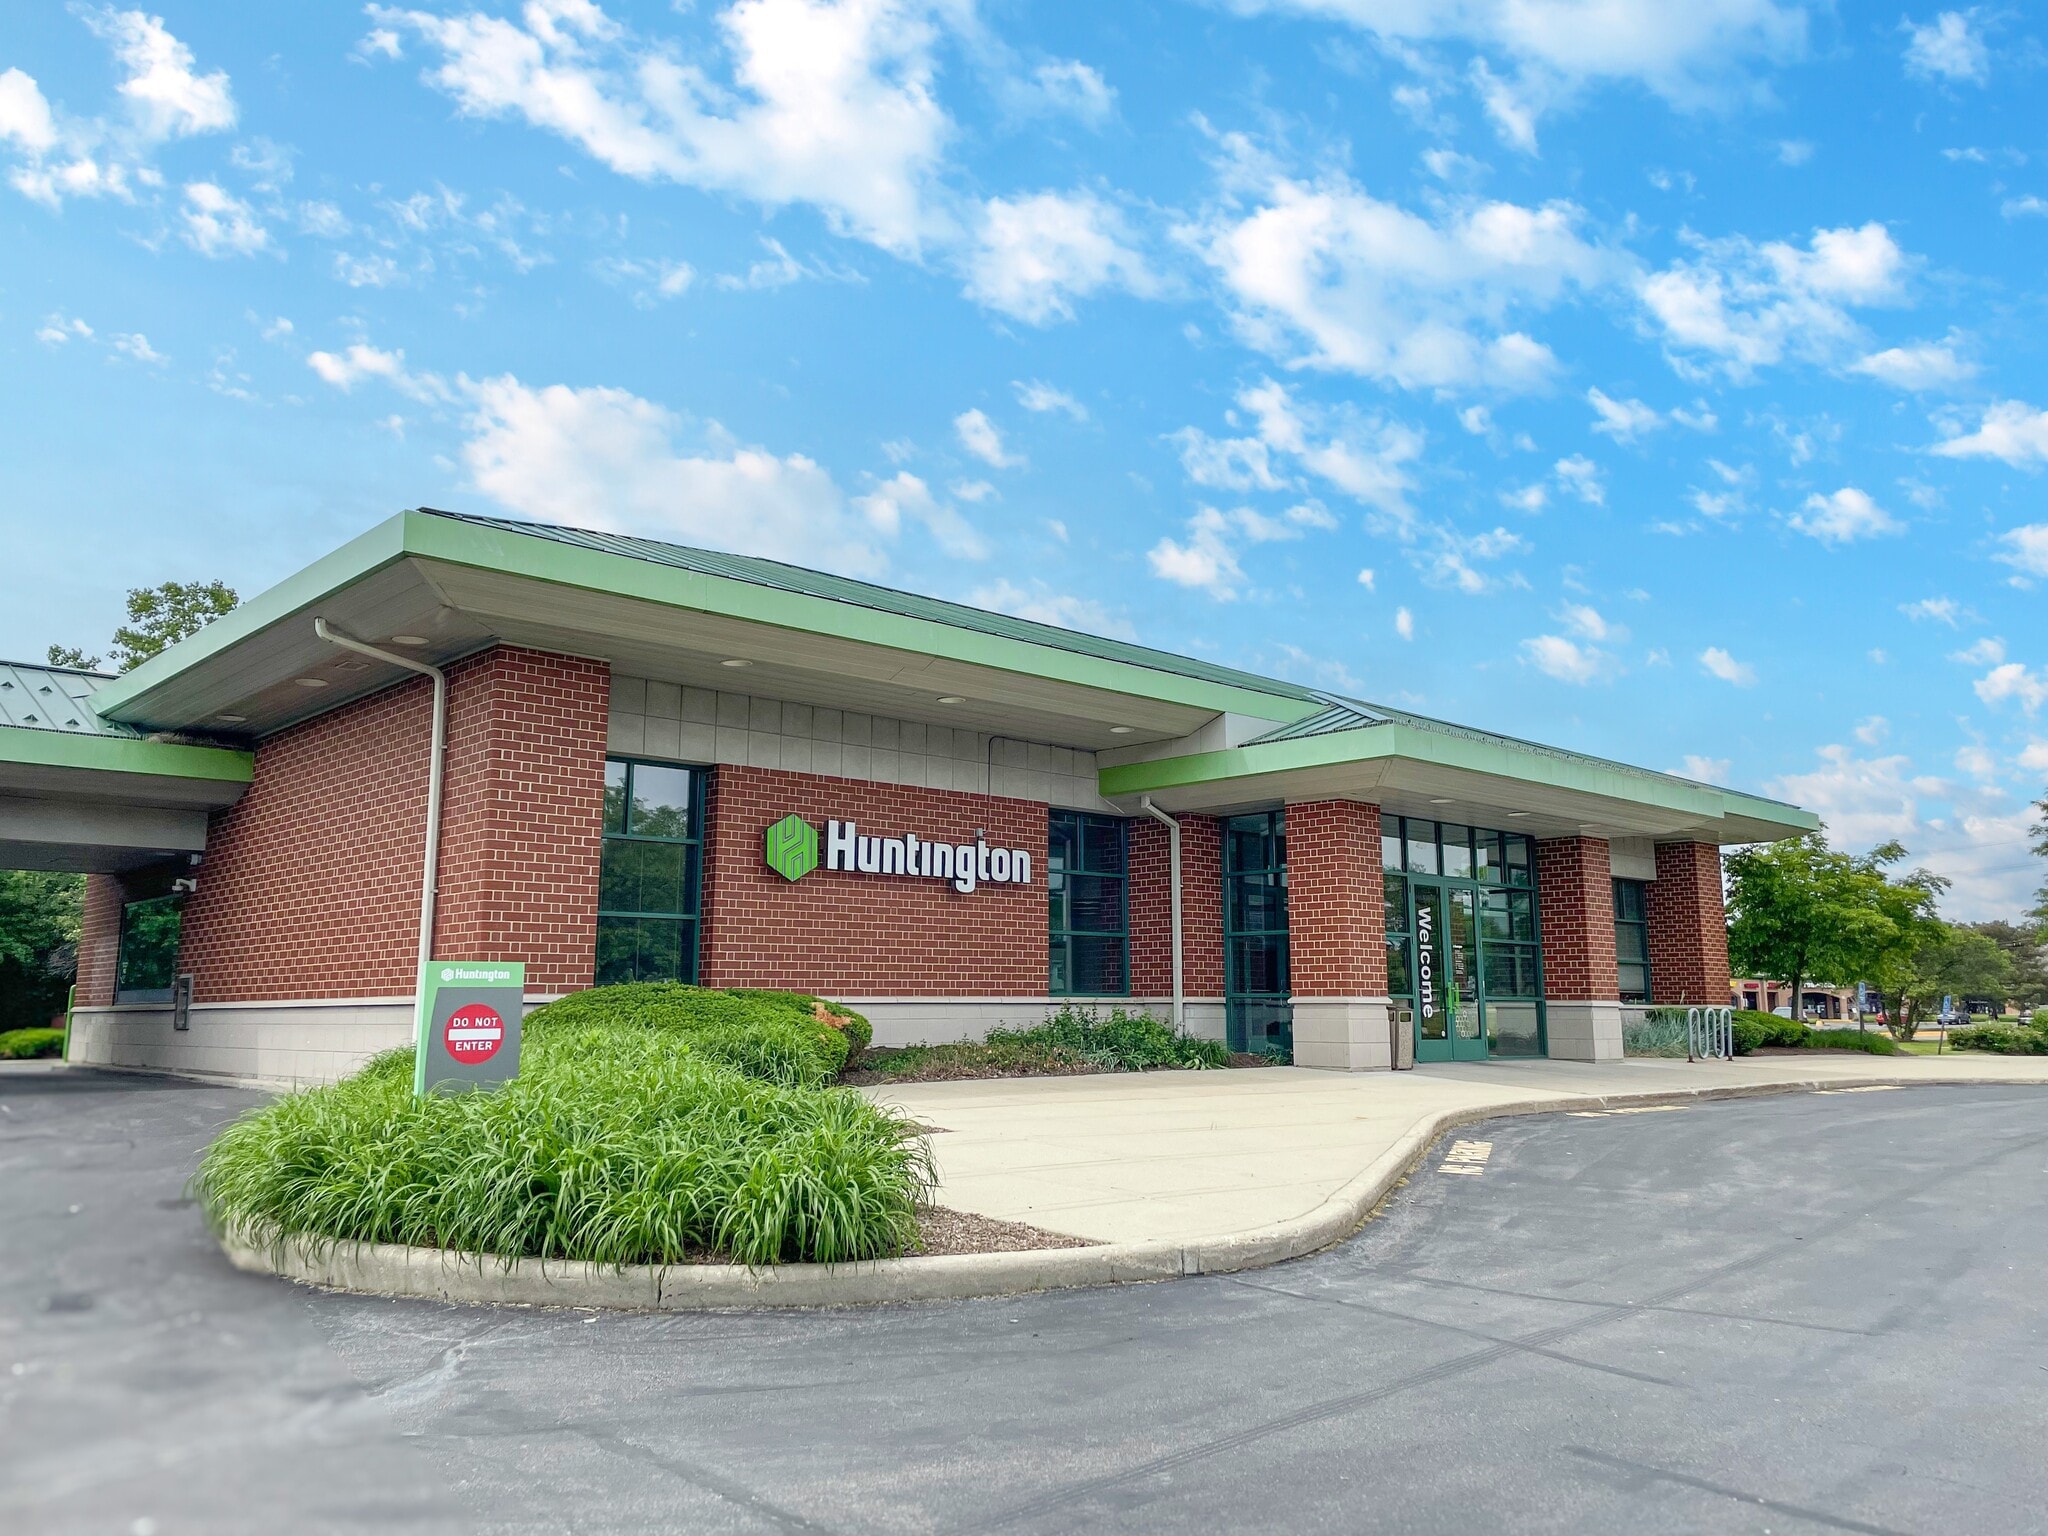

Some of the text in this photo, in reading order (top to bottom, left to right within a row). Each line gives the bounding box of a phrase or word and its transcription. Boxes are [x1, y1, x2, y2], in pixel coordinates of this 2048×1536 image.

[827, 819, 1031, 893] Huntington
[1418, 907, 1433, 1018] Welcome
[455, 968, 510, 982] Huntington
[453, 1017, 498, 1027] DO NOT
[455, 1041, 493, 1051] ENTER
